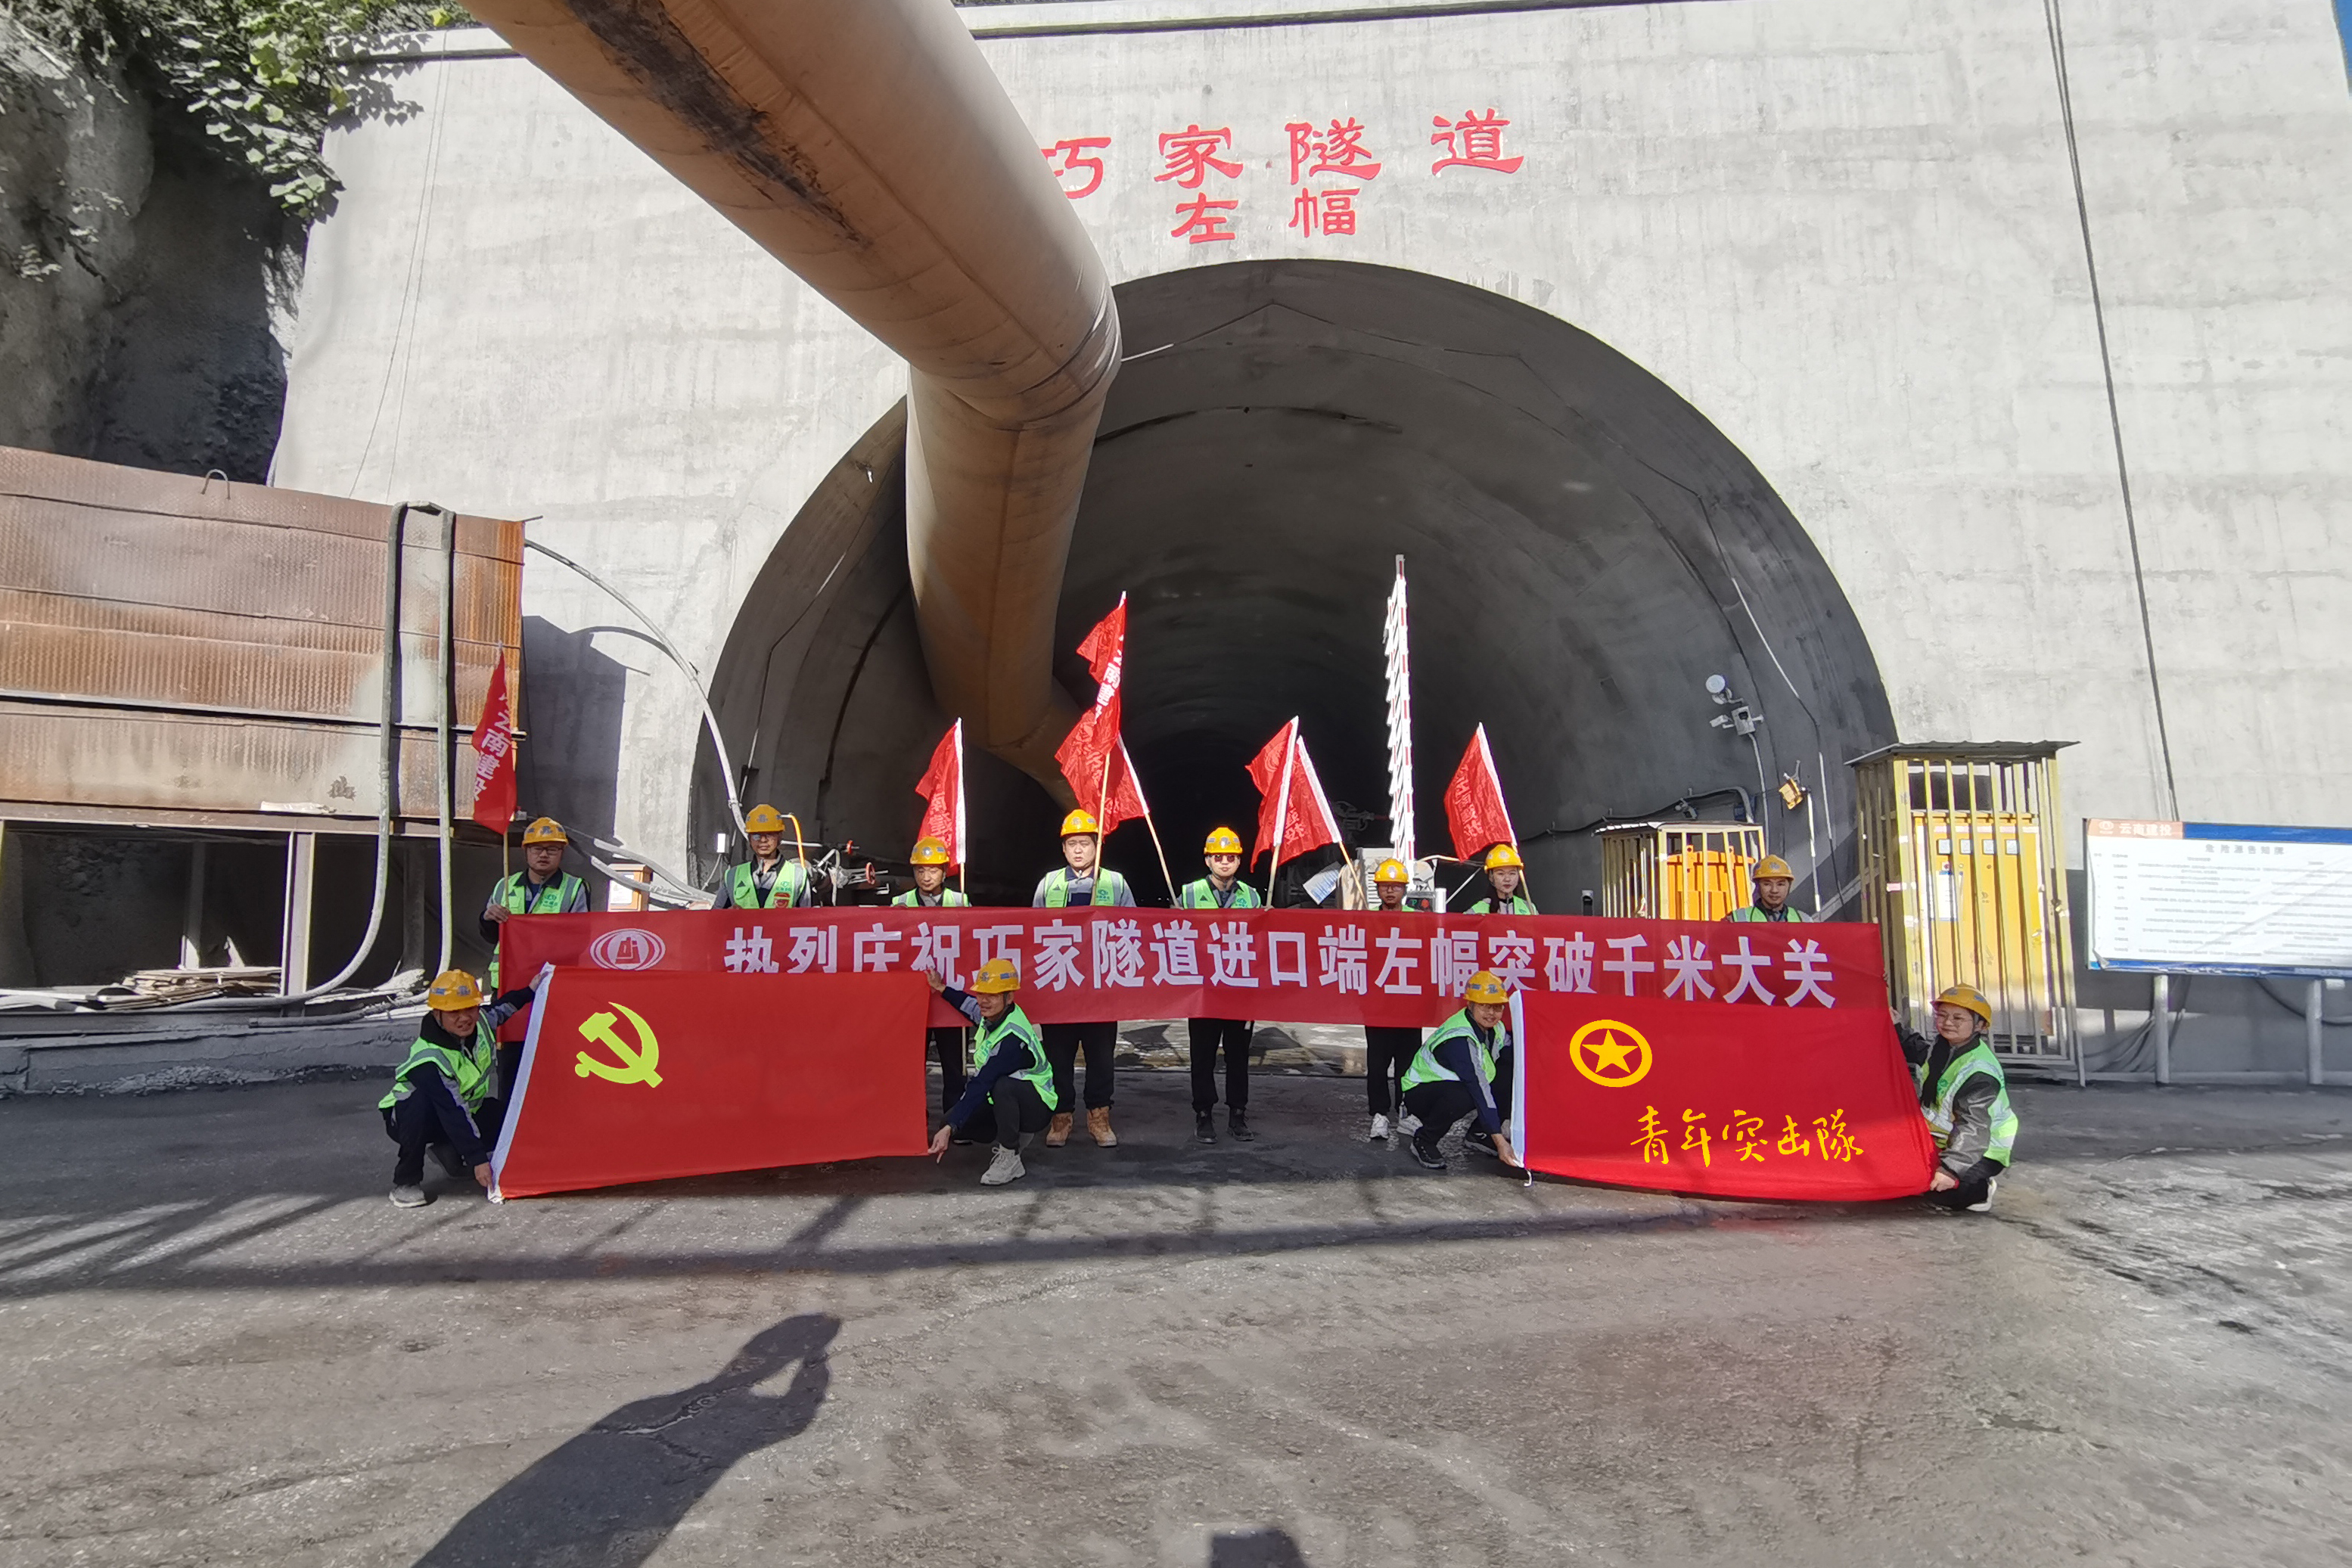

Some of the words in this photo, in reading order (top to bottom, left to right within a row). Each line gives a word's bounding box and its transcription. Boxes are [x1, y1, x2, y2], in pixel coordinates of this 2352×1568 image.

[1039, 107, 1524, 200] 巧家隧道
[1170, 187, 1361, 244] 左幅
